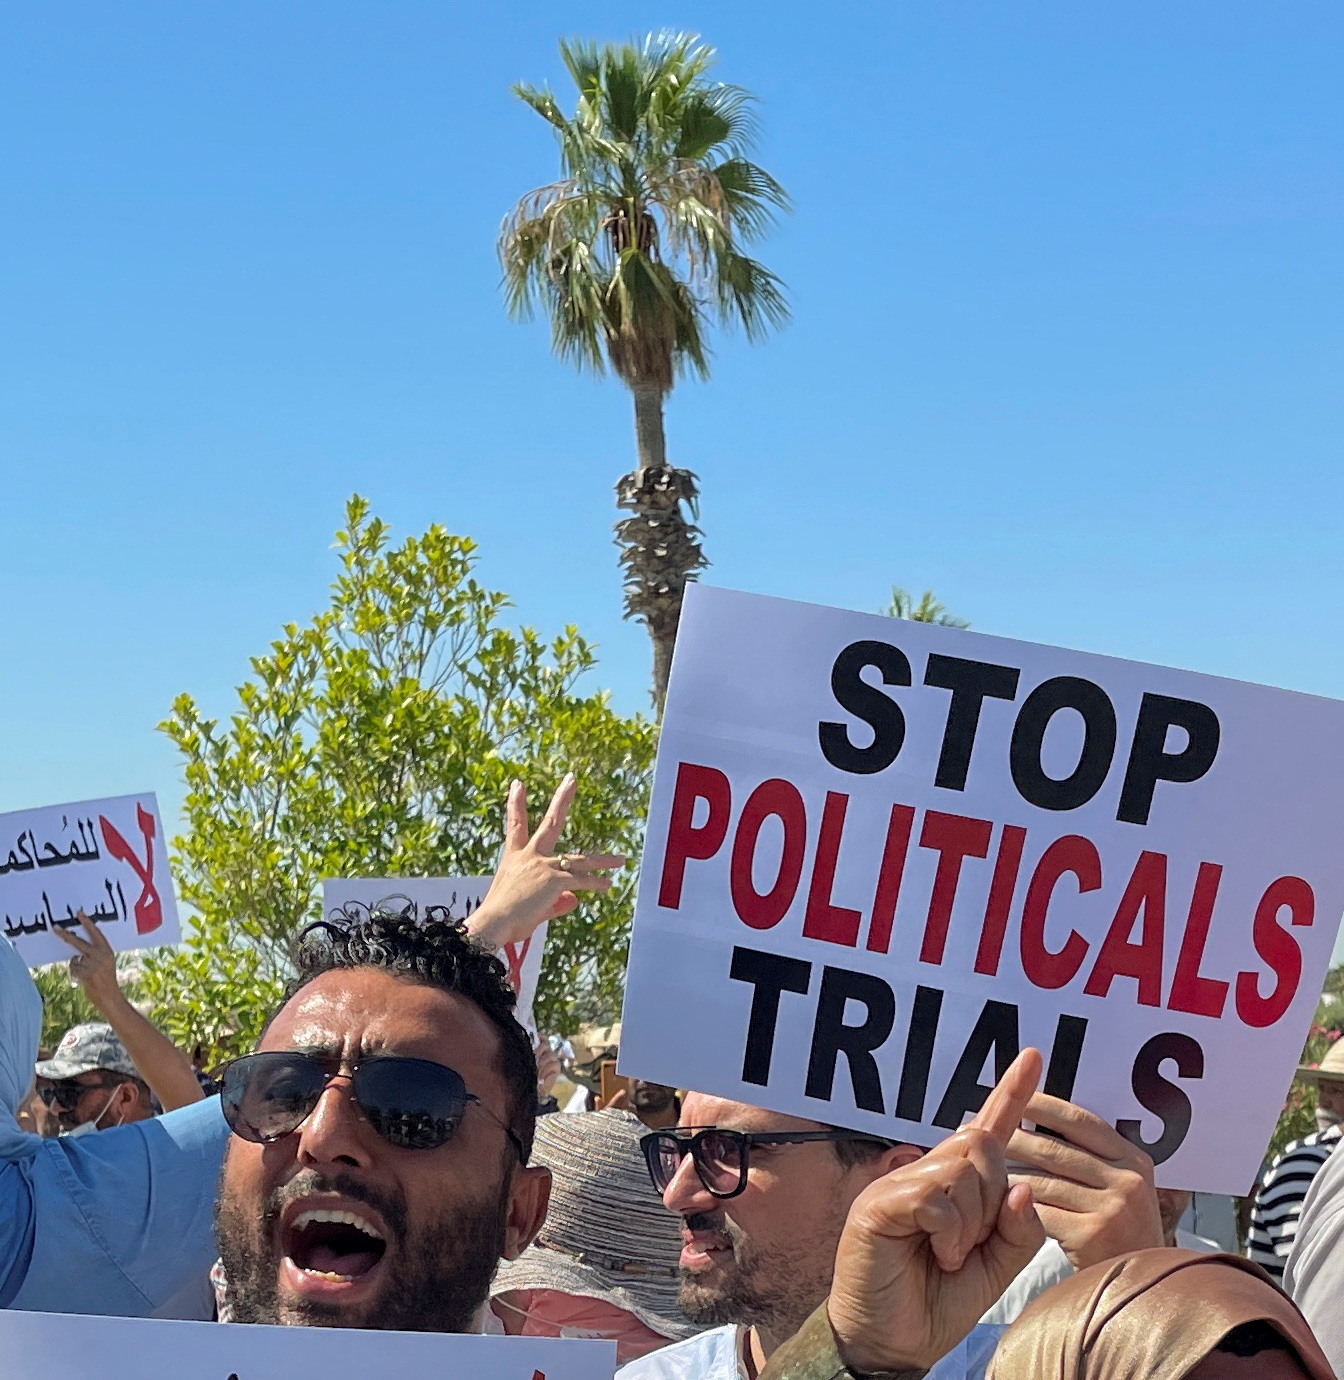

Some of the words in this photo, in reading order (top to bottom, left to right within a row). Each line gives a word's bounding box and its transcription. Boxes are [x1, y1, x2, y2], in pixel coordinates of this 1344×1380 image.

[818, 640, 1221, 827] STOP
[99, 801, 163, 936] لا
[657, 761, 1316, 1028] POLITICALS
[729, 945, 1205, 1167] TRIALS
